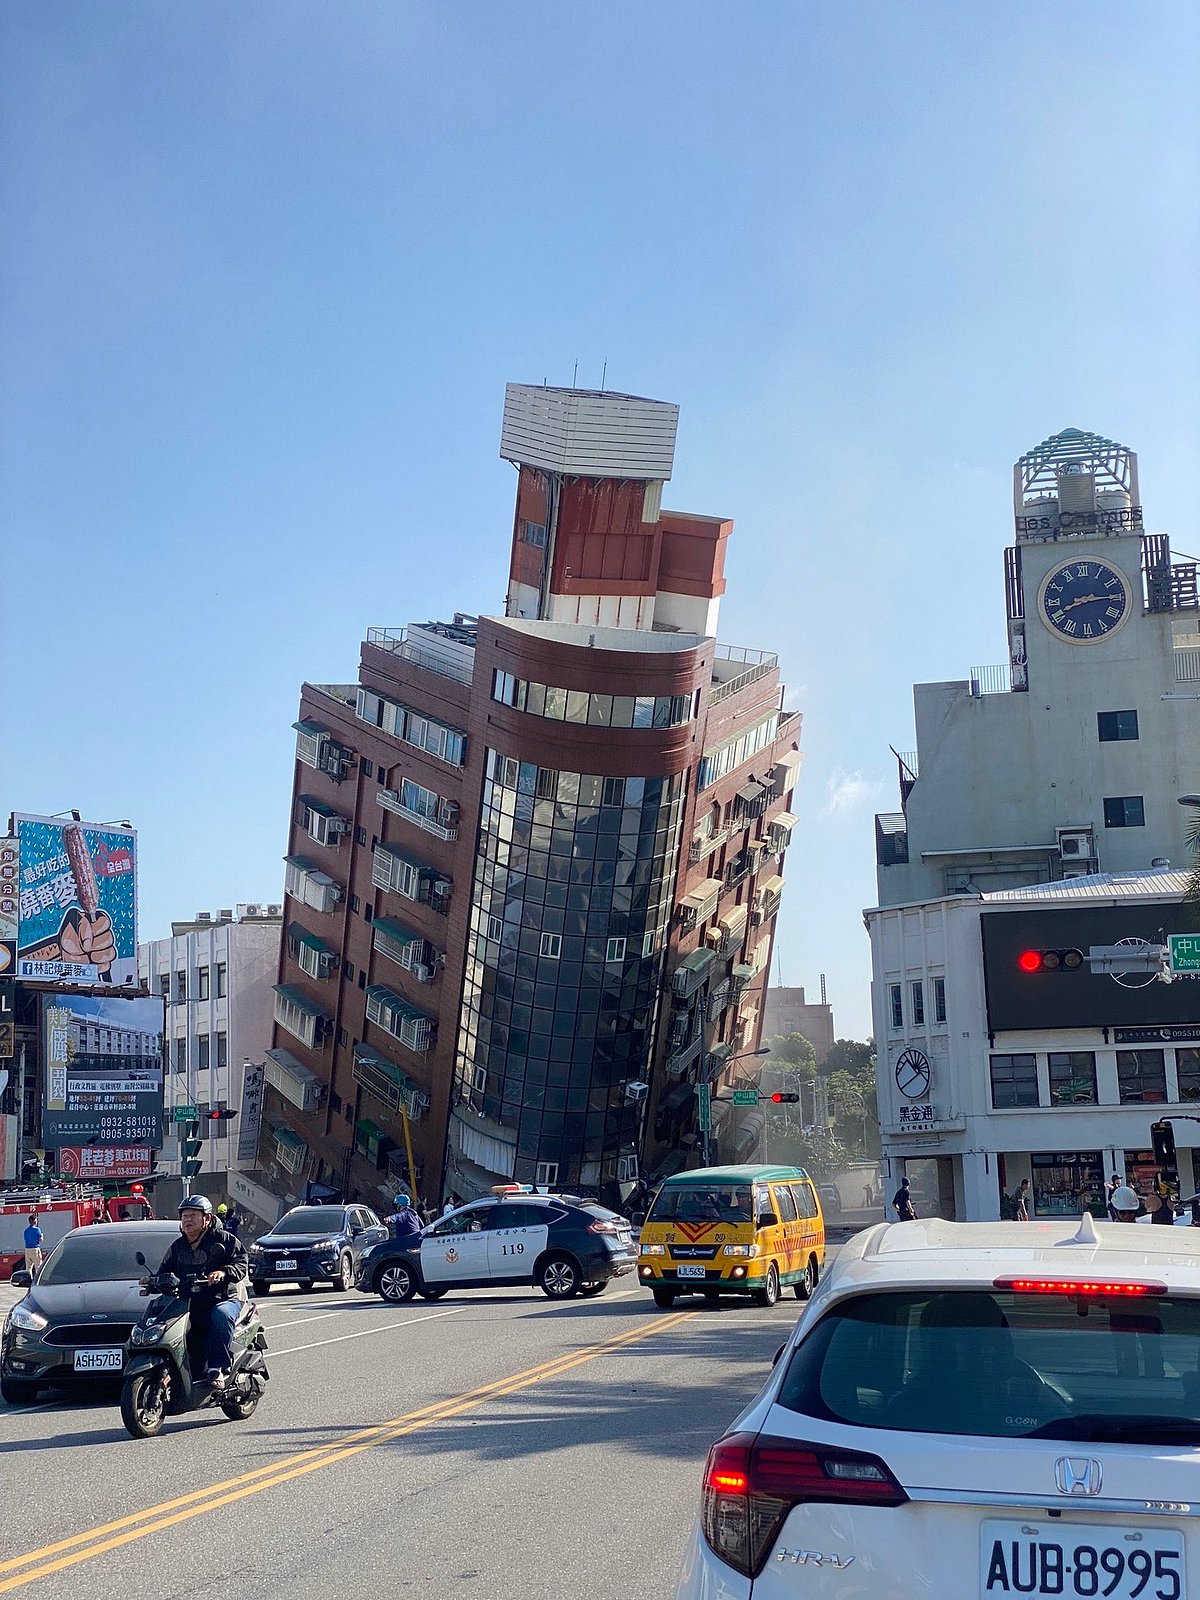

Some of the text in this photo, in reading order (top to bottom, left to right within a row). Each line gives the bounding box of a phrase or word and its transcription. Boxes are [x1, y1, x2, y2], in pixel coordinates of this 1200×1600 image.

[23, 852, 71, 885] 最好吃的
[33, 961, 82, 977] 林記燒番麥
[101, 1116, 157, 1127] 0932-581018
[899, 1105, 933, 1122] 黑金通
[100, 1128, 157, 1139] 0905-935071
[502, 1243, 525, 1256] 119
[776, 1546, 856, 1570] HR-V
